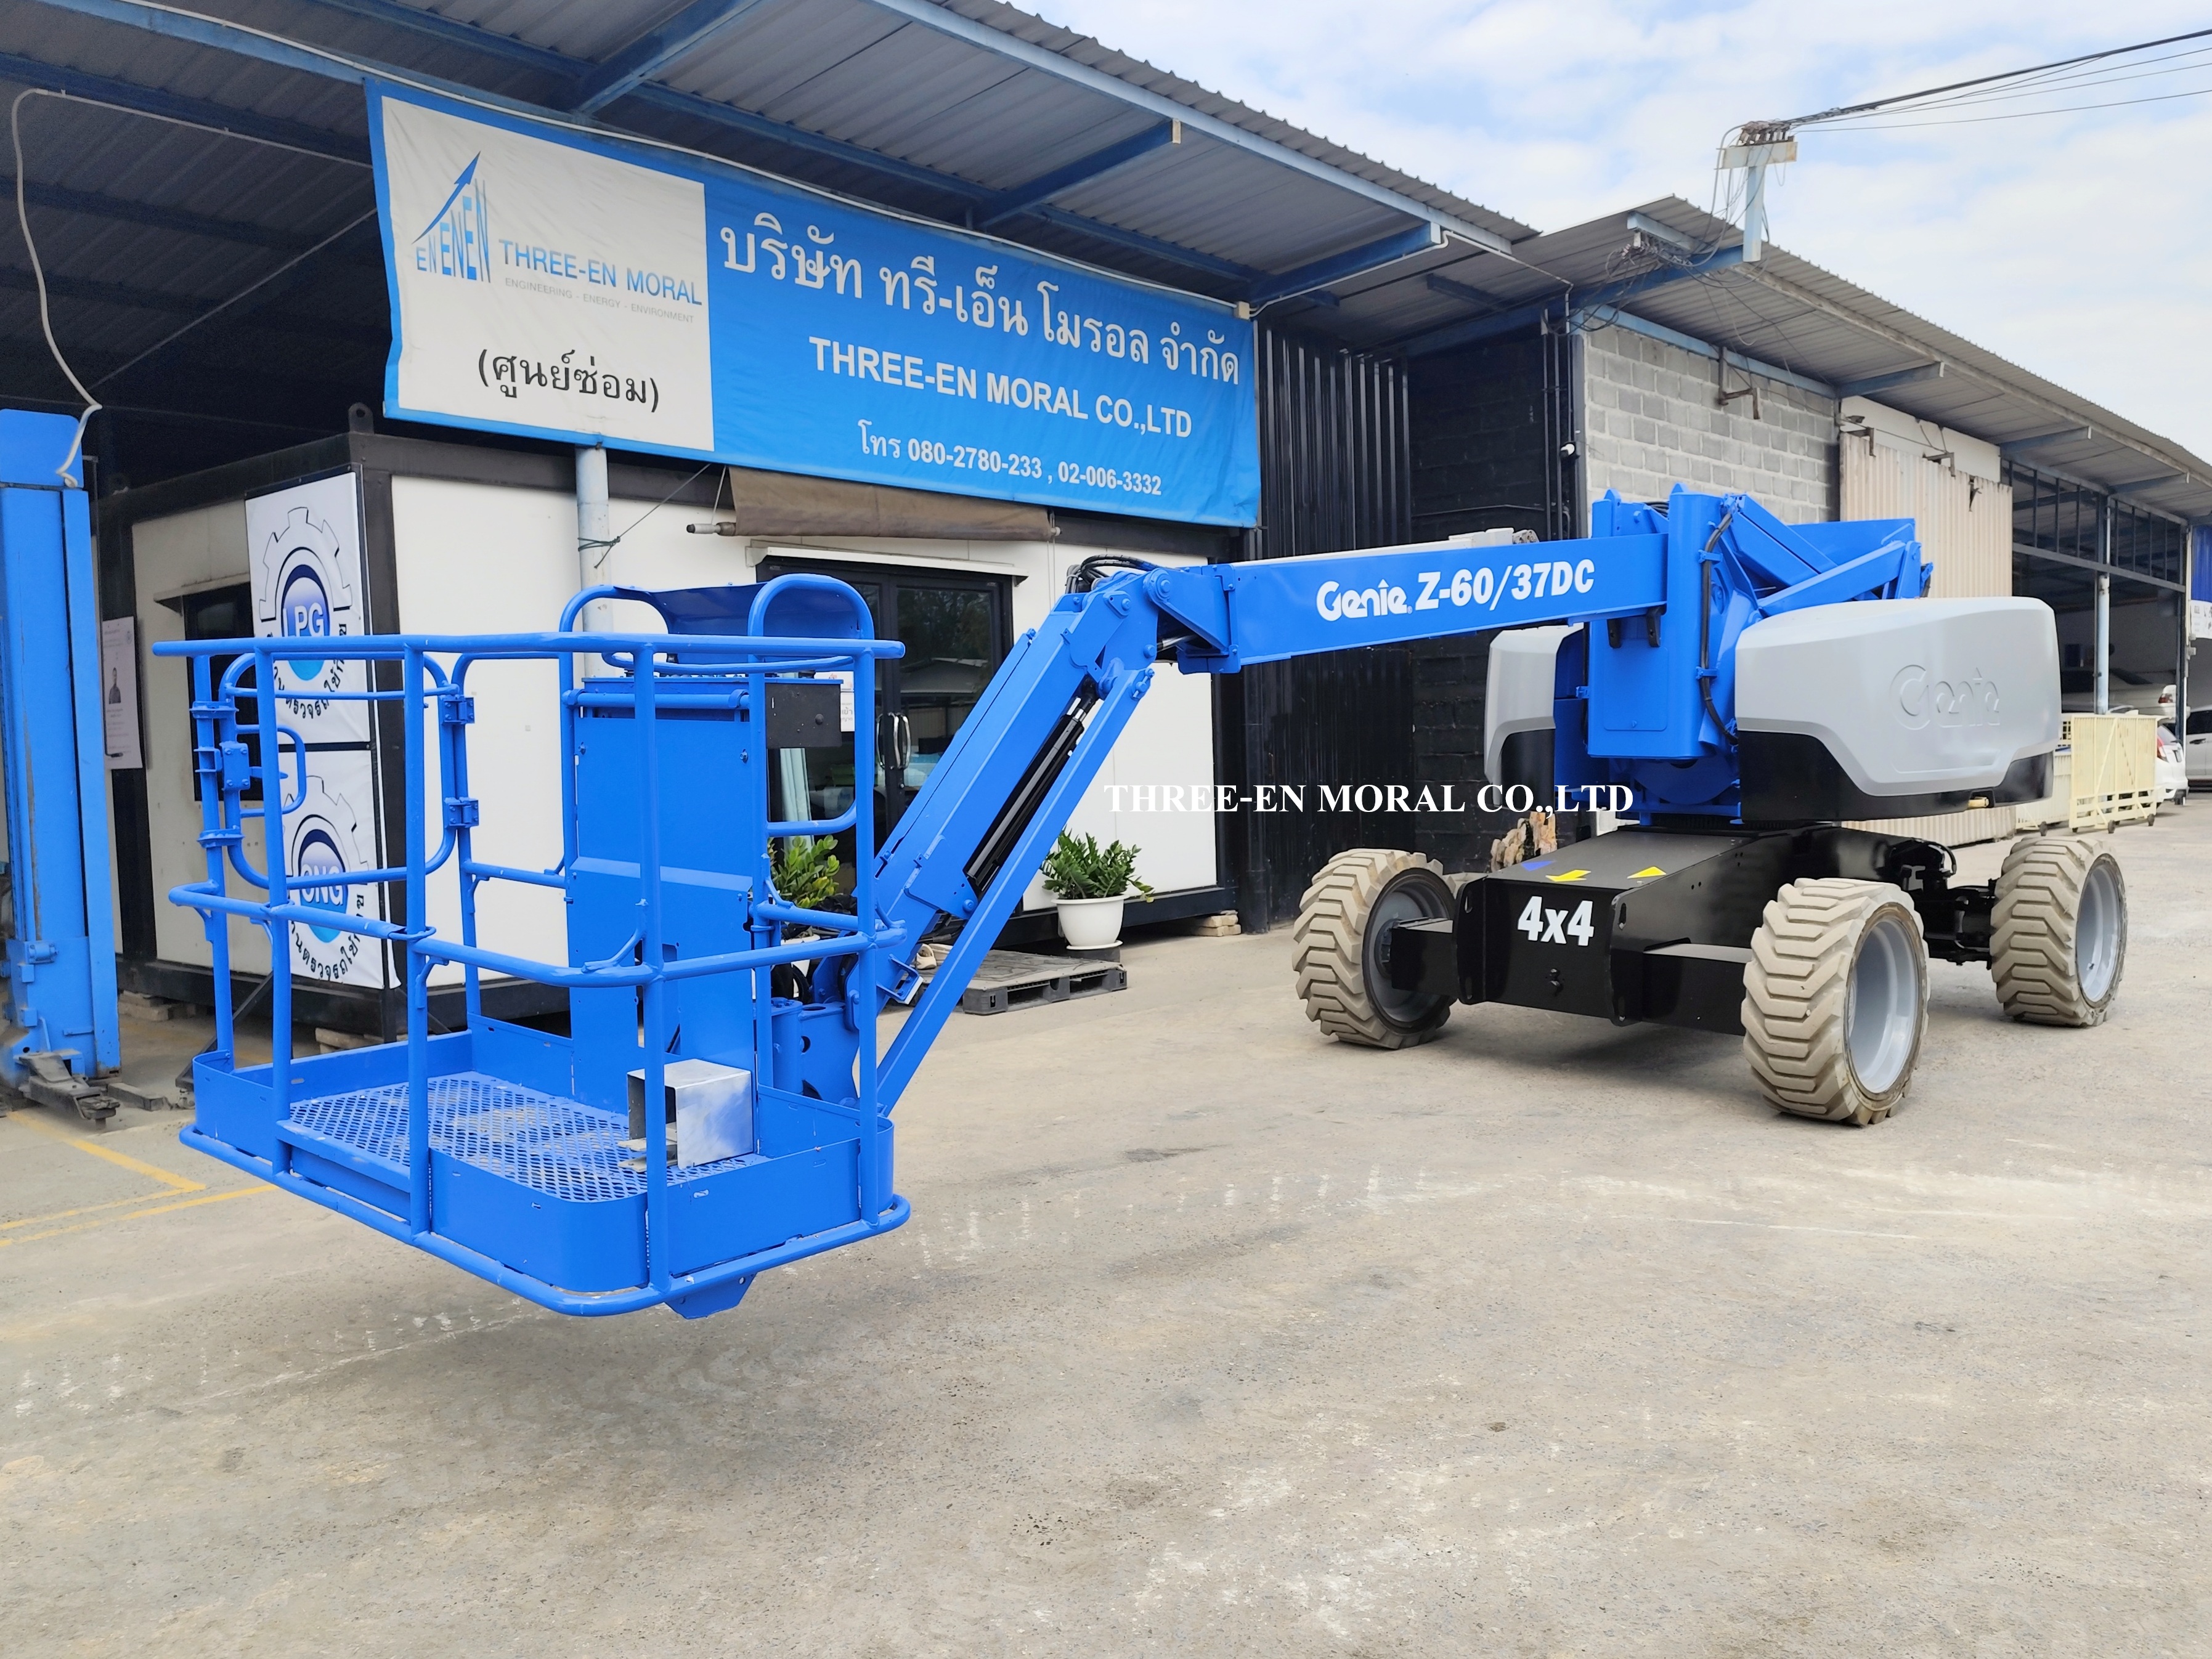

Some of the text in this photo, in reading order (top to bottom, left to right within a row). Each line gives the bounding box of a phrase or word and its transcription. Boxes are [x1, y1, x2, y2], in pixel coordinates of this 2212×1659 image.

[498, 238, 702, 306] THREE-EN MORAL
[505, 277, 573, 299] ENGINEERING
[583, 293, 621, 309] ENERGY
[631, 303, 694, 324] ENVIRONMENT
[720, 213, 1239, 385] บริษัท ทรี-เอ็น โมรอล จำกัด
[478, 349, 659, 413] (ศูนย์ซ่อม)
[809, 336, 1192, 438] THREE-EN MORAL CO.,LTD
[858, 420, 901, 458] โทร
[908, 438, 1042, 479] 080-2780-233
[1058, 461, 1162, 495] 02-006-3332
[283, 602, 325, 637] LPG
[1316, 559, 1595, 622] Genie Z-60/37DC
[1890, 665, 2000, 731] Genie
[1518, 896, 1595, 946] 4x4
